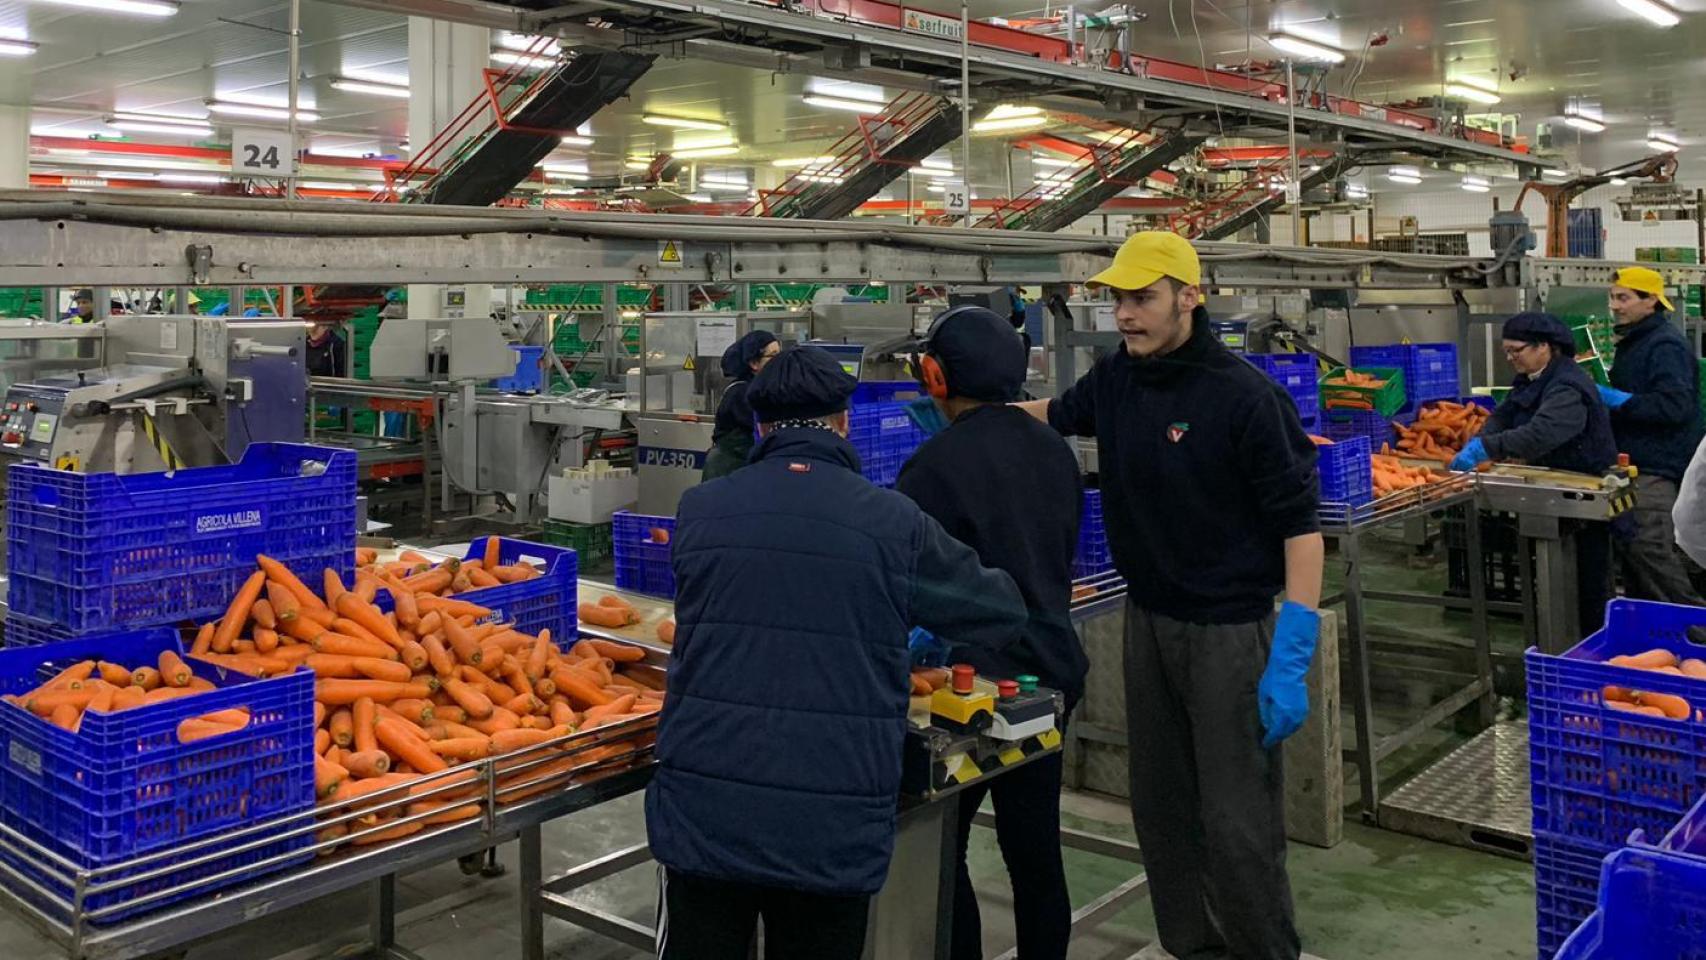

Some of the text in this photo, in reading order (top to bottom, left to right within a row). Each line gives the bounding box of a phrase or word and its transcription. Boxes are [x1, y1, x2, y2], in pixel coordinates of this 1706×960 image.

[243, 143, 279, 169] 24
[949, 192, 964, 207] 25
[645, 449, 696, 469] PV-350
[196, 513, 233, 530] AGRICOLA
[232, 510, 261, 524] VILLENA
